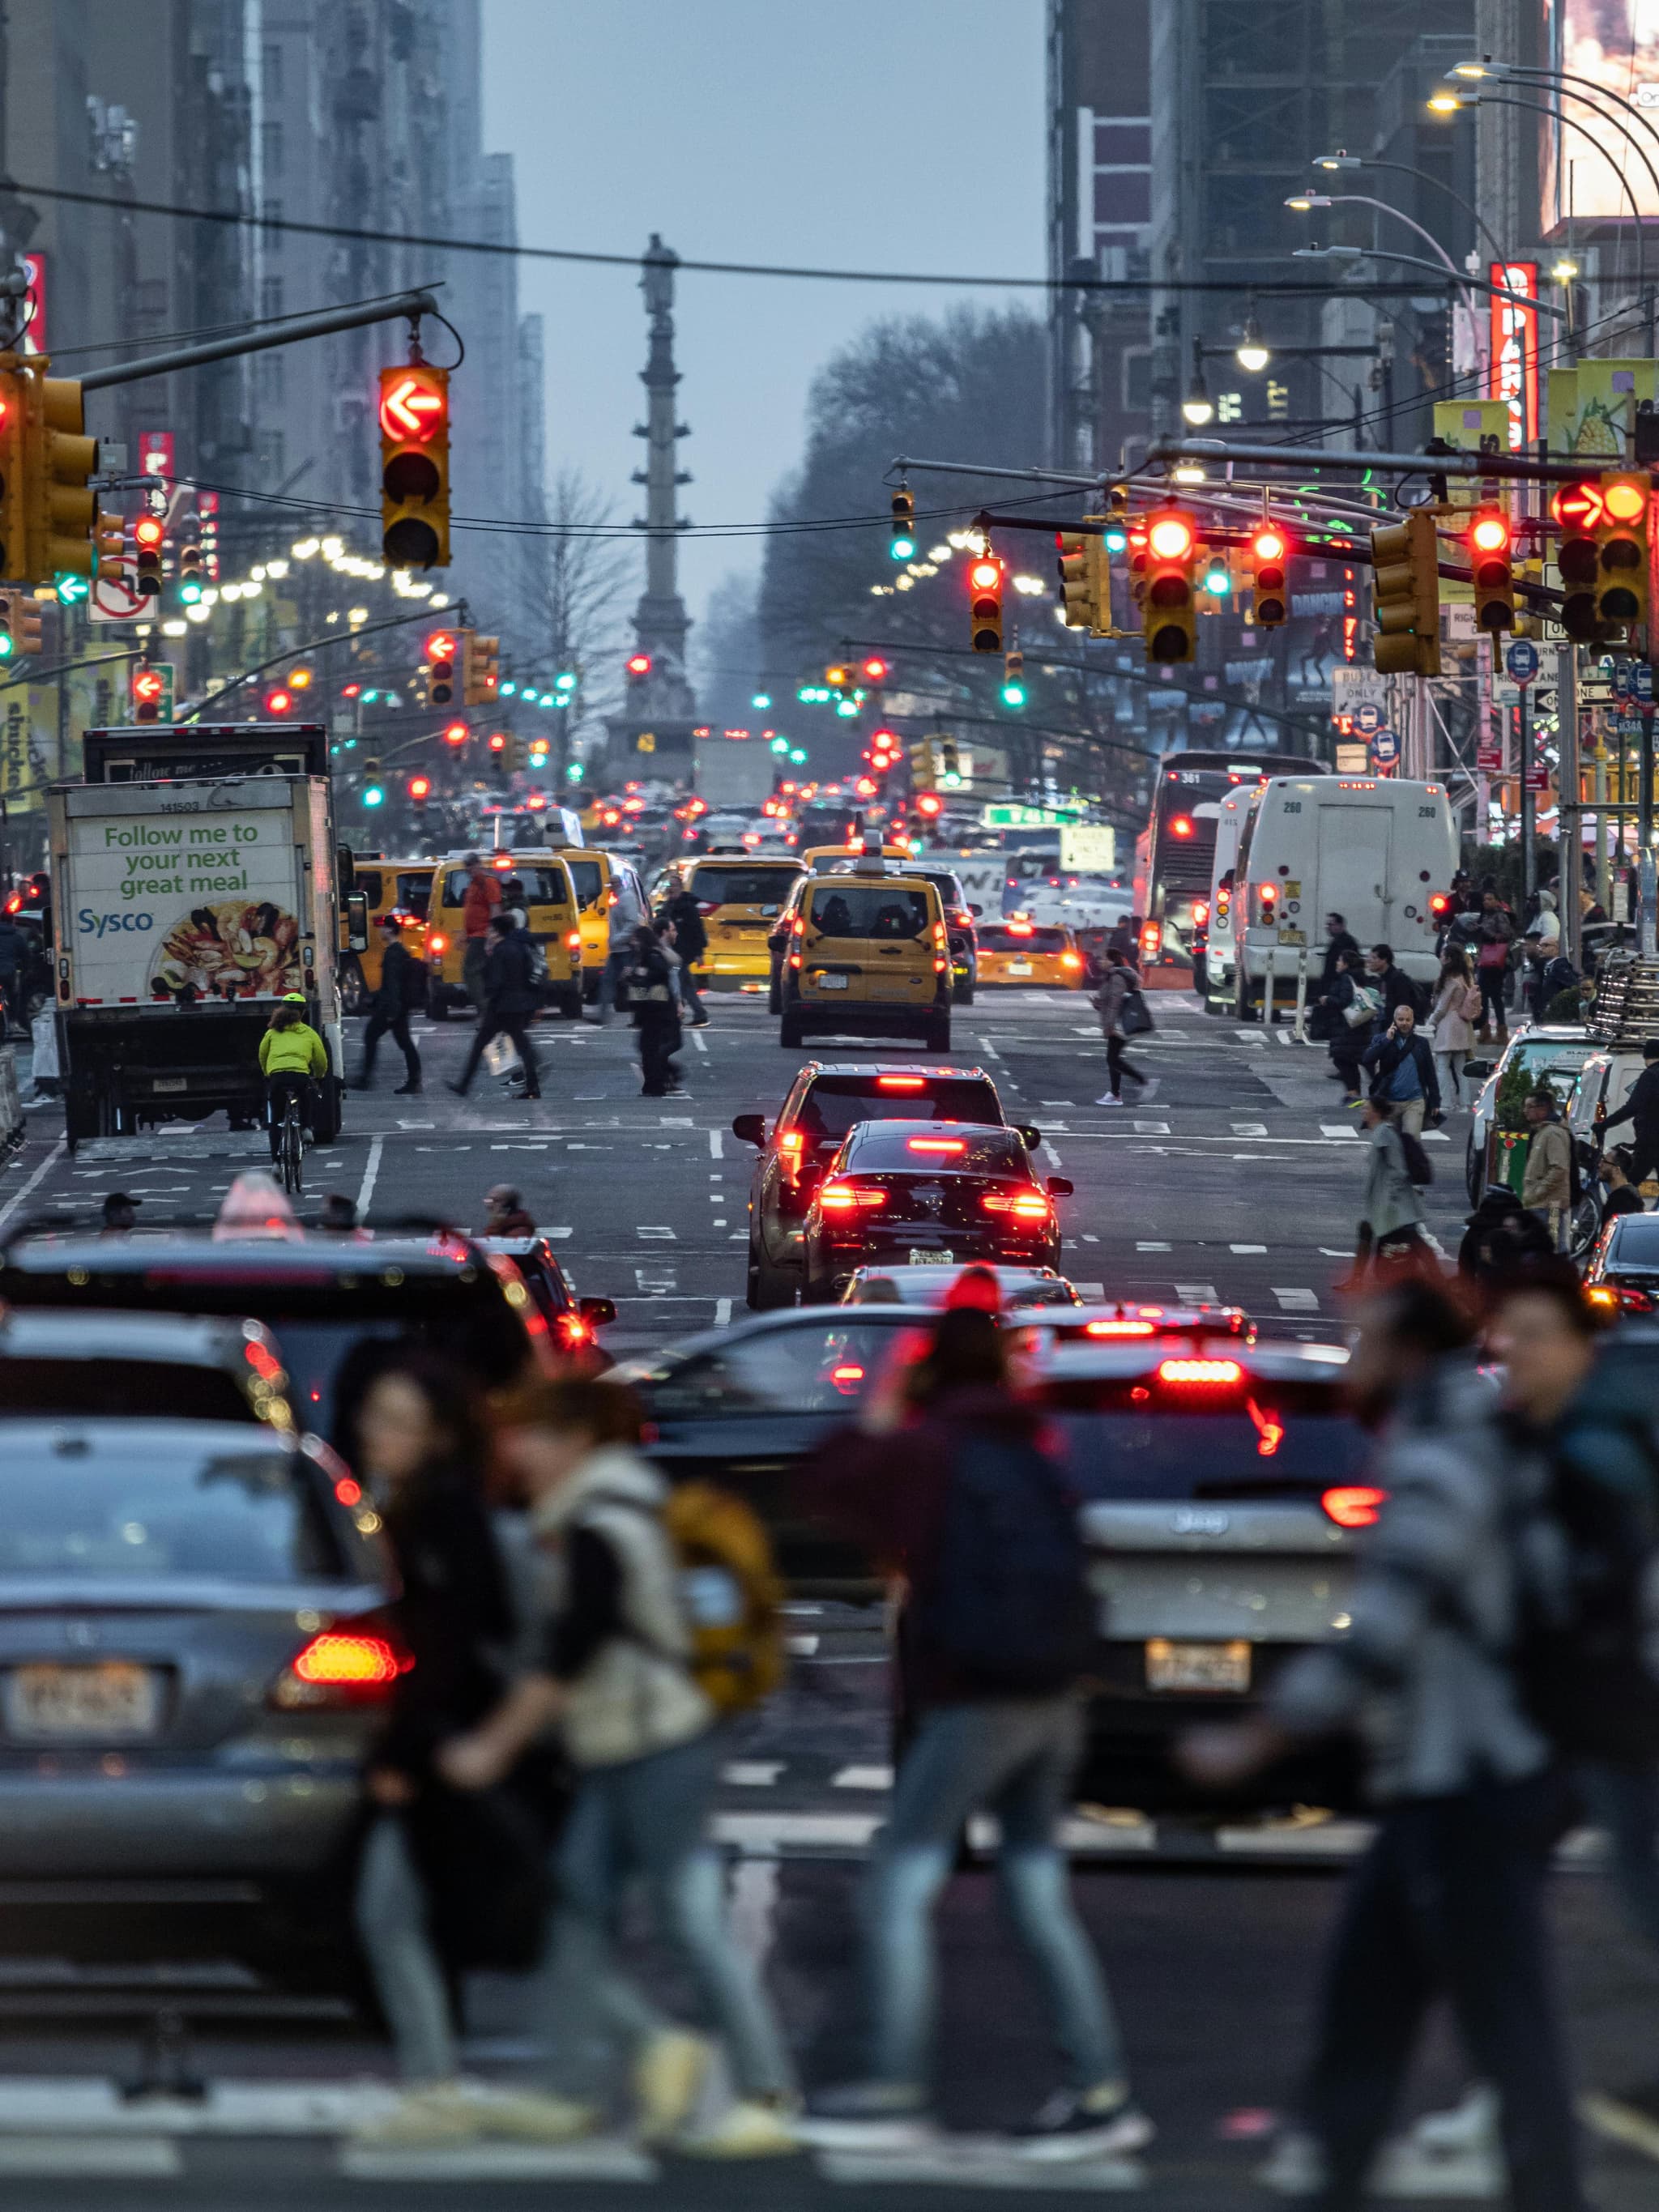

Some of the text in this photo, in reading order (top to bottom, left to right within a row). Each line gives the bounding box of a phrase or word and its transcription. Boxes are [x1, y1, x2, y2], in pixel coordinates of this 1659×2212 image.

[104, 824, 258, 846] Follow me to
[126, 849, 240, 876] your next
[121, 869, 247, 901] great meal
[79, 908, 154, 939] Sysco
